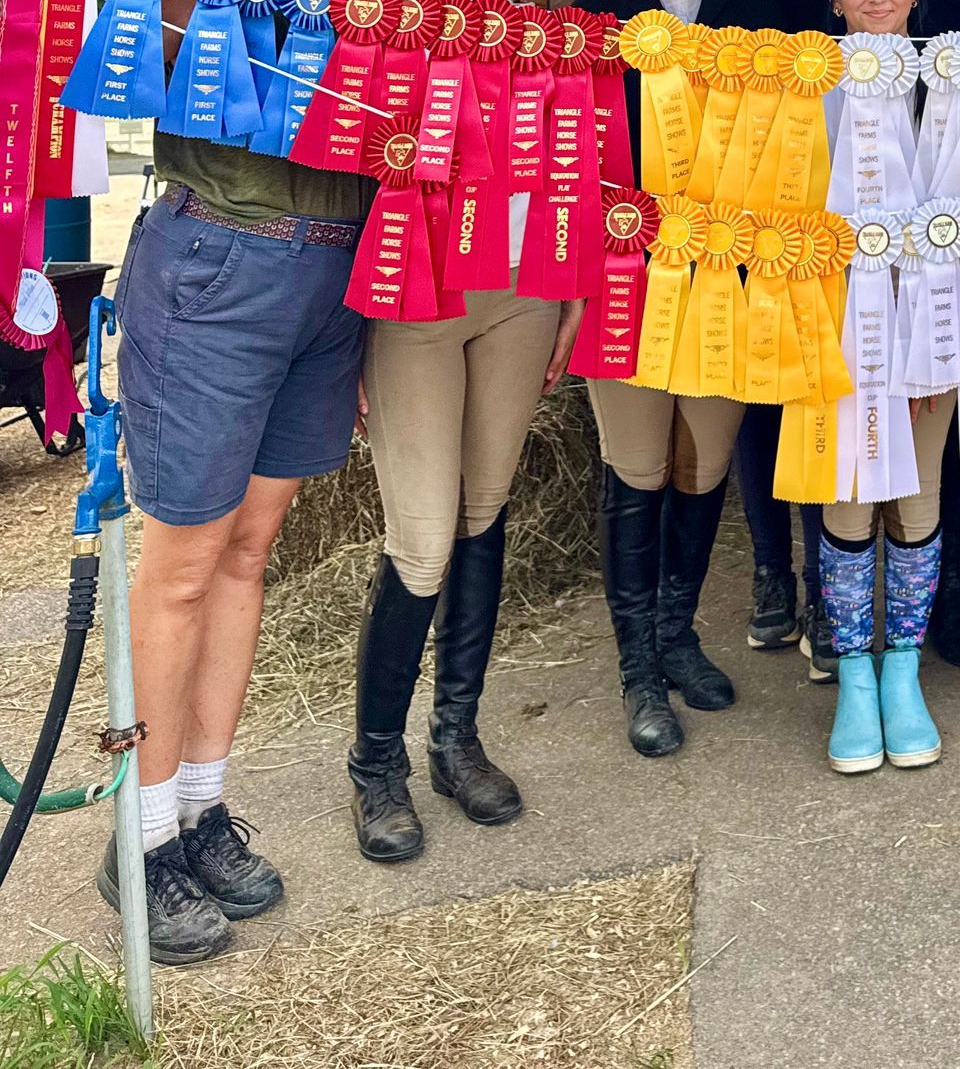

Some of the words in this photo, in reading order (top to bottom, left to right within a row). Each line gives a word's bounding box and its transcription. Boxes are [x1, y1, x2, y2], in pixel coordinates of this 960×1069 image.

[51, 3, 80, 11] TRIANGLE
[116, 9, 147, 21] TRIANGLE
[53, 21, 75, 29] FARMS
[117, 22, 139, 33] FARMS
[198, 31, 228, 39] TRIANGLE
[52, 38, 74, 47] HORSE
[114, 35, 136, 45] HORSE
[200, 43, 222, 51] FARMS
[110, 48, 135, 58] SHOWS
[50, 55, 73, 64] SHOWS
[199, 56, 220, 64] HORSE
[196, 69, 220, 77] SHOWS
[341, 65, 369, 74] TRIANGLE
[386, 72, 416, 81] TRIANGLE
[105, 80, 128, 90] FIRST
[343, 78, 363, 87] FARMS
[431, 79, 460, 87] TRIANGLE
[389, 85, 410, 93] FARMS
[101, 92, 126, 102] PLACE
[432, 91, 454, 99] FARMS
[514, 90, 542, 98] TRIANGLE
[194, 101, 216, 109] FIRST
[387, 98, 409, 106] HORSE
[431, 102, 452, 110] HORSE
[517, 102, 537, 110] FARMS
[338, 104, 360, 112] SHOWS
[554, 108, 582, 116] TRIANGLE
[428, 114, 452, 123] SHOWS
[516, 114, 537, 122] HORSE
[557, 120, 578, 128] FARMS
[854, 120, 880, 128] TRIANGLE
[514, 126, 537, 135] SHOWS
[667, 129, 686, 140] SHOWS
[556, 131, 577, 139] HORSE
[330, 135, 360, 144] SECOND
[331, 147, 356, 155] PLACE
[420, 144, 451, 153] SECOND
[555, 143, 577, 151] SHOWS
[3, 104, 18, 214] TWELFTH
[421, 156, 446, 165] PLACE
[511, 157, 540, 165] SECOND
[671, 158, 690, 168] THIRD
[858, 156, 879, 164] SHOWS
[671, 168, 690, 179] PLACE
[557, 184, 570, 192] FLAT
[857, 185, 883, 193] FOURTH
[549, 195, 579, 203] CHALLENGE
[859, 197, 881, 205] PLACE
[382, 211, 410, 222] TRIANGLE
[384, 225, 404, 235] FARMS
[459, 199, 477, 255] SECOND
[555, 207, 569, 262] SECOND
[381, 238, 403, 247] HORSE
[379, 251, 401, 260] SHOWS
[607, 275, 635, 283] TRIANGLE
[371, 283, 400, 292] SECOND
[610, 287, 630, 295] FARMS
[930, 286, 953, 296] TRIANGLE
[372, 295, 396, 304] PLACE
[934, 303, 952, 311] FARMS
[859, 311, 884, 319] TRIANGLE
[862, 323, 881, 331] FARMS
[934, 319, 952, 328] HORSE
[862, 336, 881, 344] HORSE
[935, 334, 954, 344] SHOWS
[602, 344, 631, 352] SECOND
[862, 349, 883, 357] SHOWS
[604, 356, 627, 364] PLACE
[867, 394, 878, 402] CUP
[816, 414, 825, 454] THIRD
[867, 406, 878, 460] FOURTH
